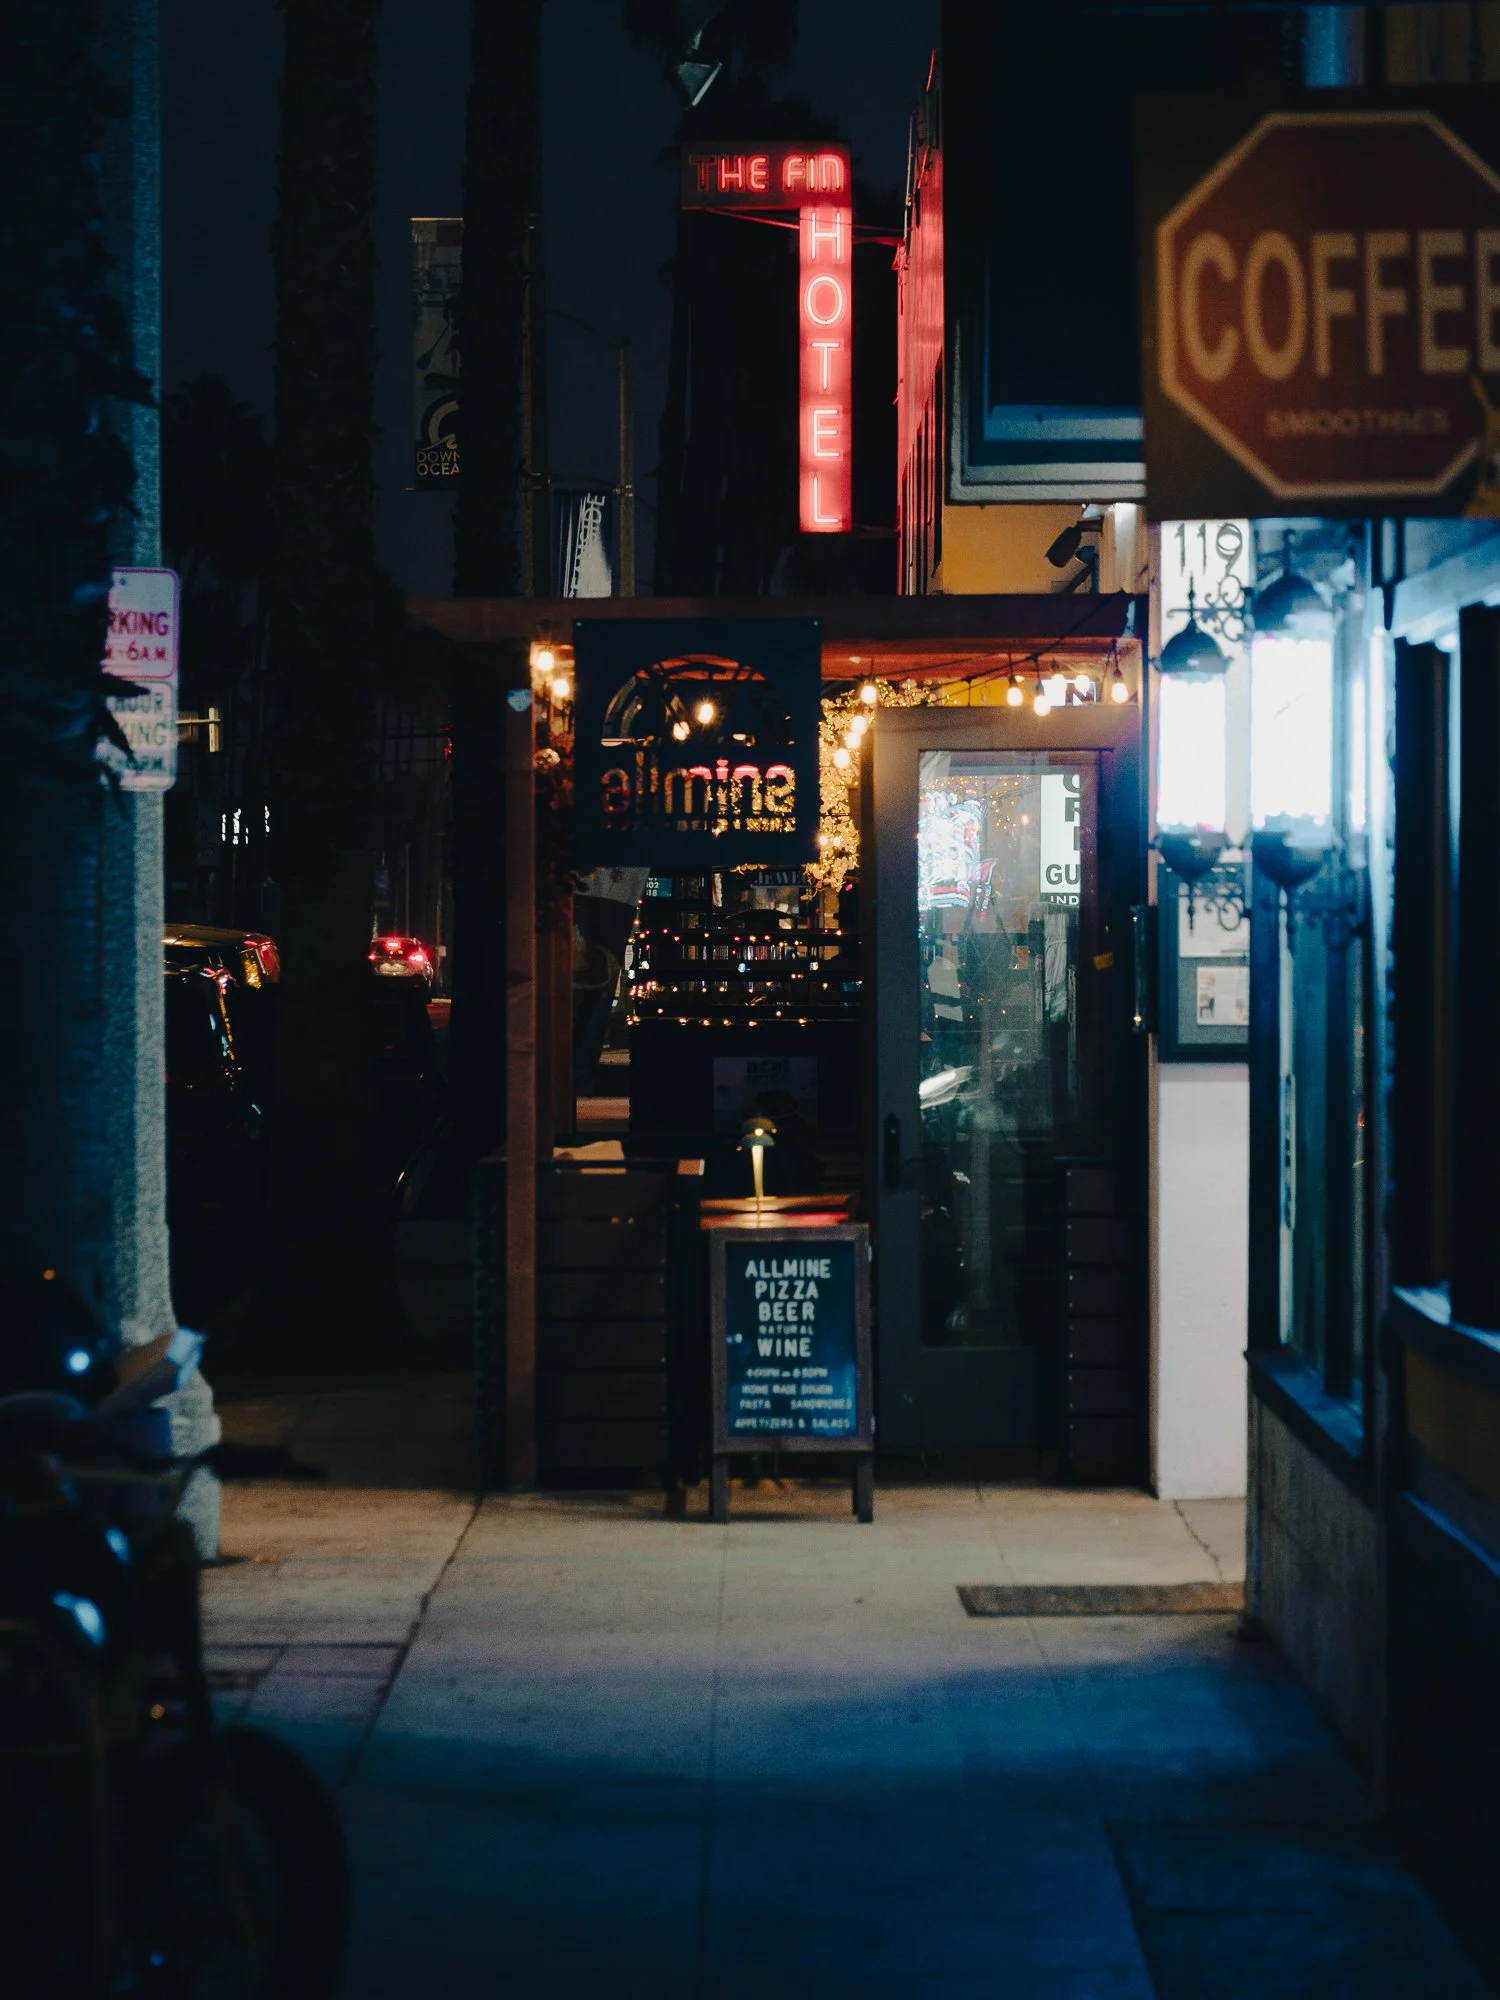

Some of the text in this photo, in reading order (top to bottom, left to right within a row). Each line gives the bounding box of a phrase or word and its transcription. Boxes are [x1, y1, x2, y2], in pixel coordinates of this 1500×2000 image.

[689, 154, 768, 192] THE
[1180, 229, 1500, 382] COFFEE
[804, 208, 846, 526] HOTEL
[1175, 522, 1243, 577] 119
[601, 750, 797, 816] allmine
[744, 1258, 832, 1279] ALLMINE
[754, 1280, 819, 1300] PIZZA
[758, 1301, 815, 1322] BEER
[756, 1337, 812, 1358] WINE
